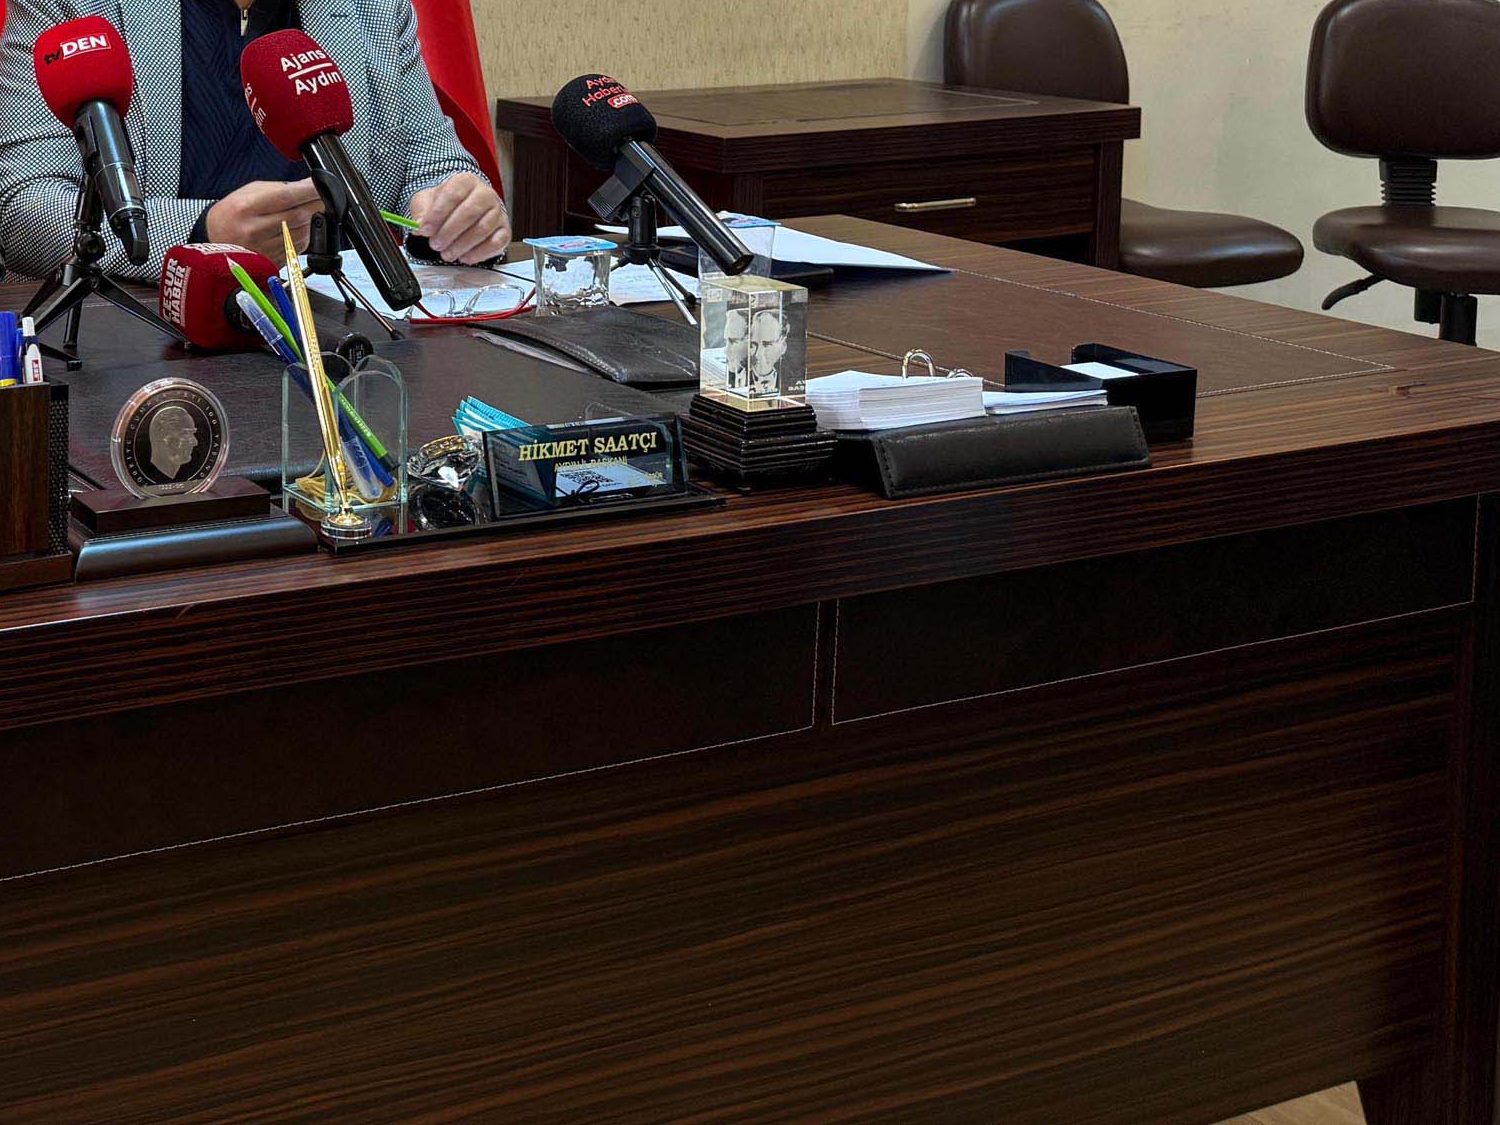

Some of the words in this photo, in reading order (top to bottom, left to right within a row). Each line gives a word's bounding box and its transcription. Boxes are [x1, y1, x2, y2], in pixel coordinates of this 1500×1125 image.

[280, 49, 327, 72] Ajans
[294, 70, 343, 96] Aydın
[162, 257, 179, 323] CESUR
[170, 264, 187, 325] HABER
[518, 438, 589, 462] HİKMET
[593, 431, 658, 454] SAATÇI
